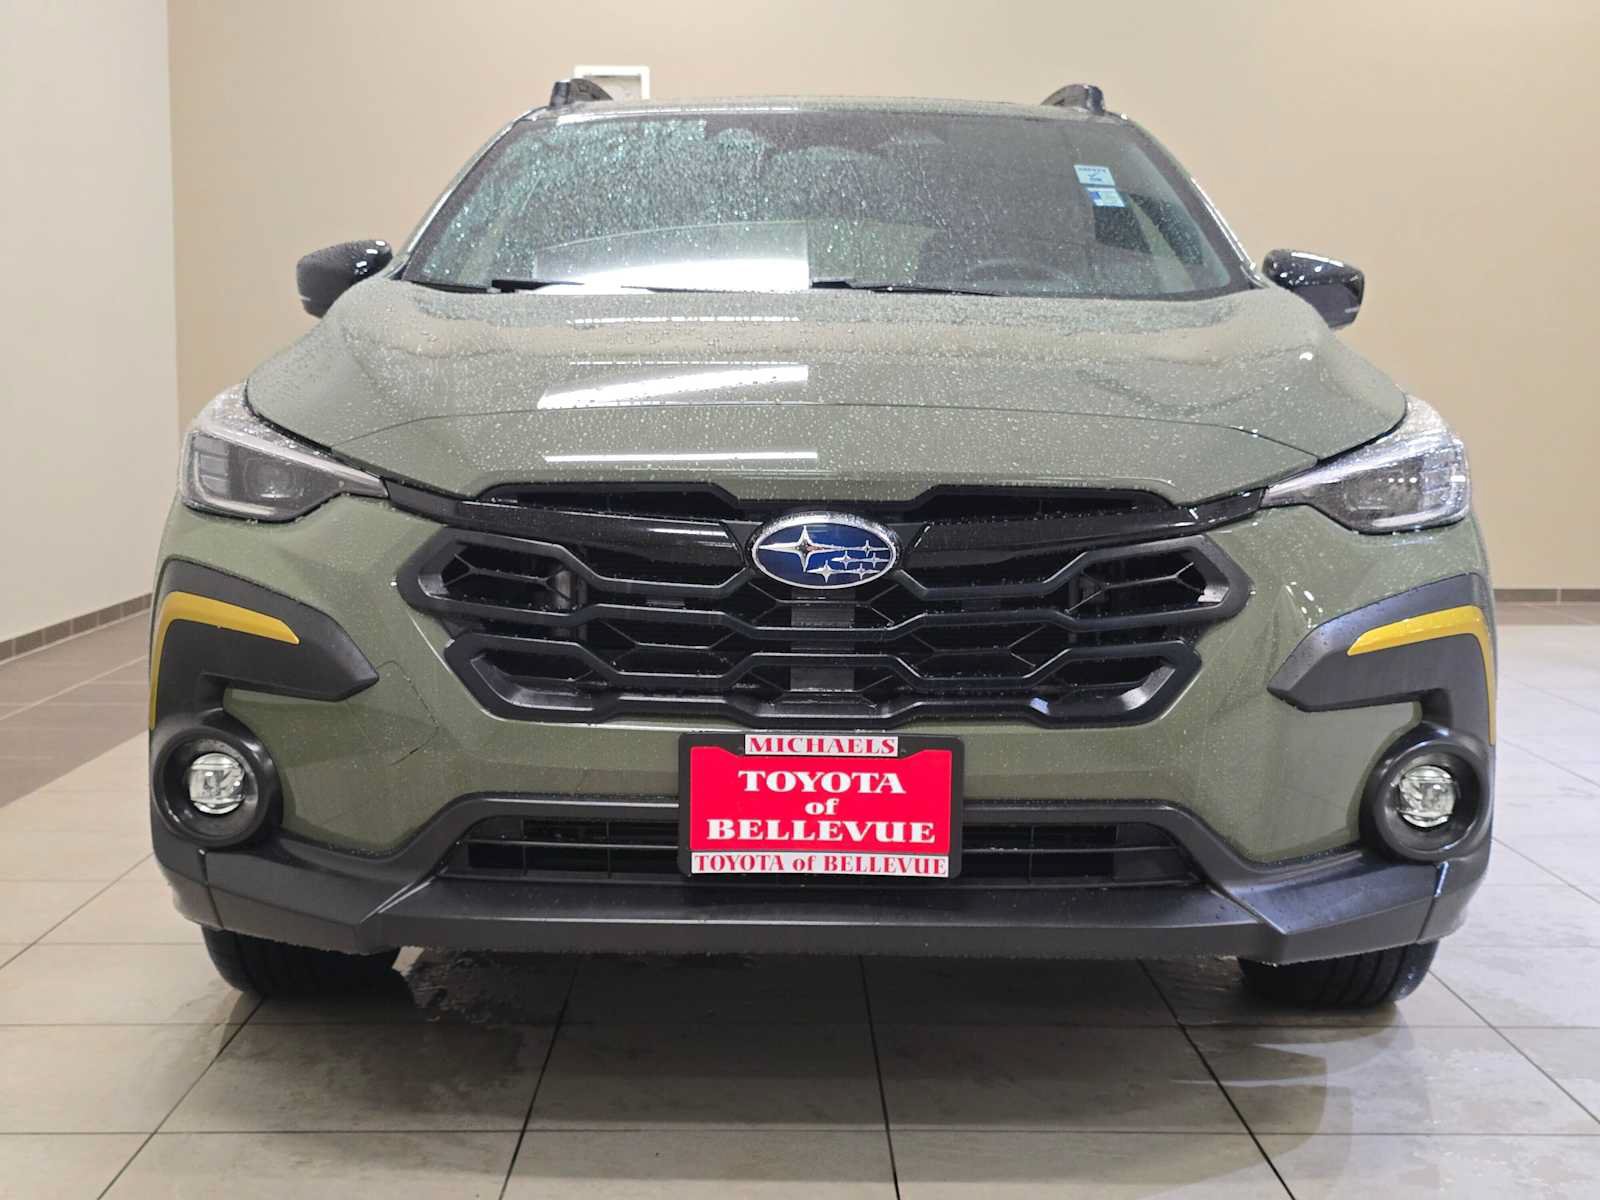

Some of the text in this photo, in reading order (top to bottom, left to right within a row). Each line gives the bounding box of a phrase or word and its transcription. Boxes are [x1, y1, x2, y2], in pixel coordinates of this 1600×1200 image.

[749, 737, 895, 754] MICHAELS
[738, 770, 906, 794] TOYOTA
[804, 798, 839, 816] of
[706, 819, 935, 843] BELLEVUE
[694, 855, 946, 875] TOYOTA of BELLEVUE
